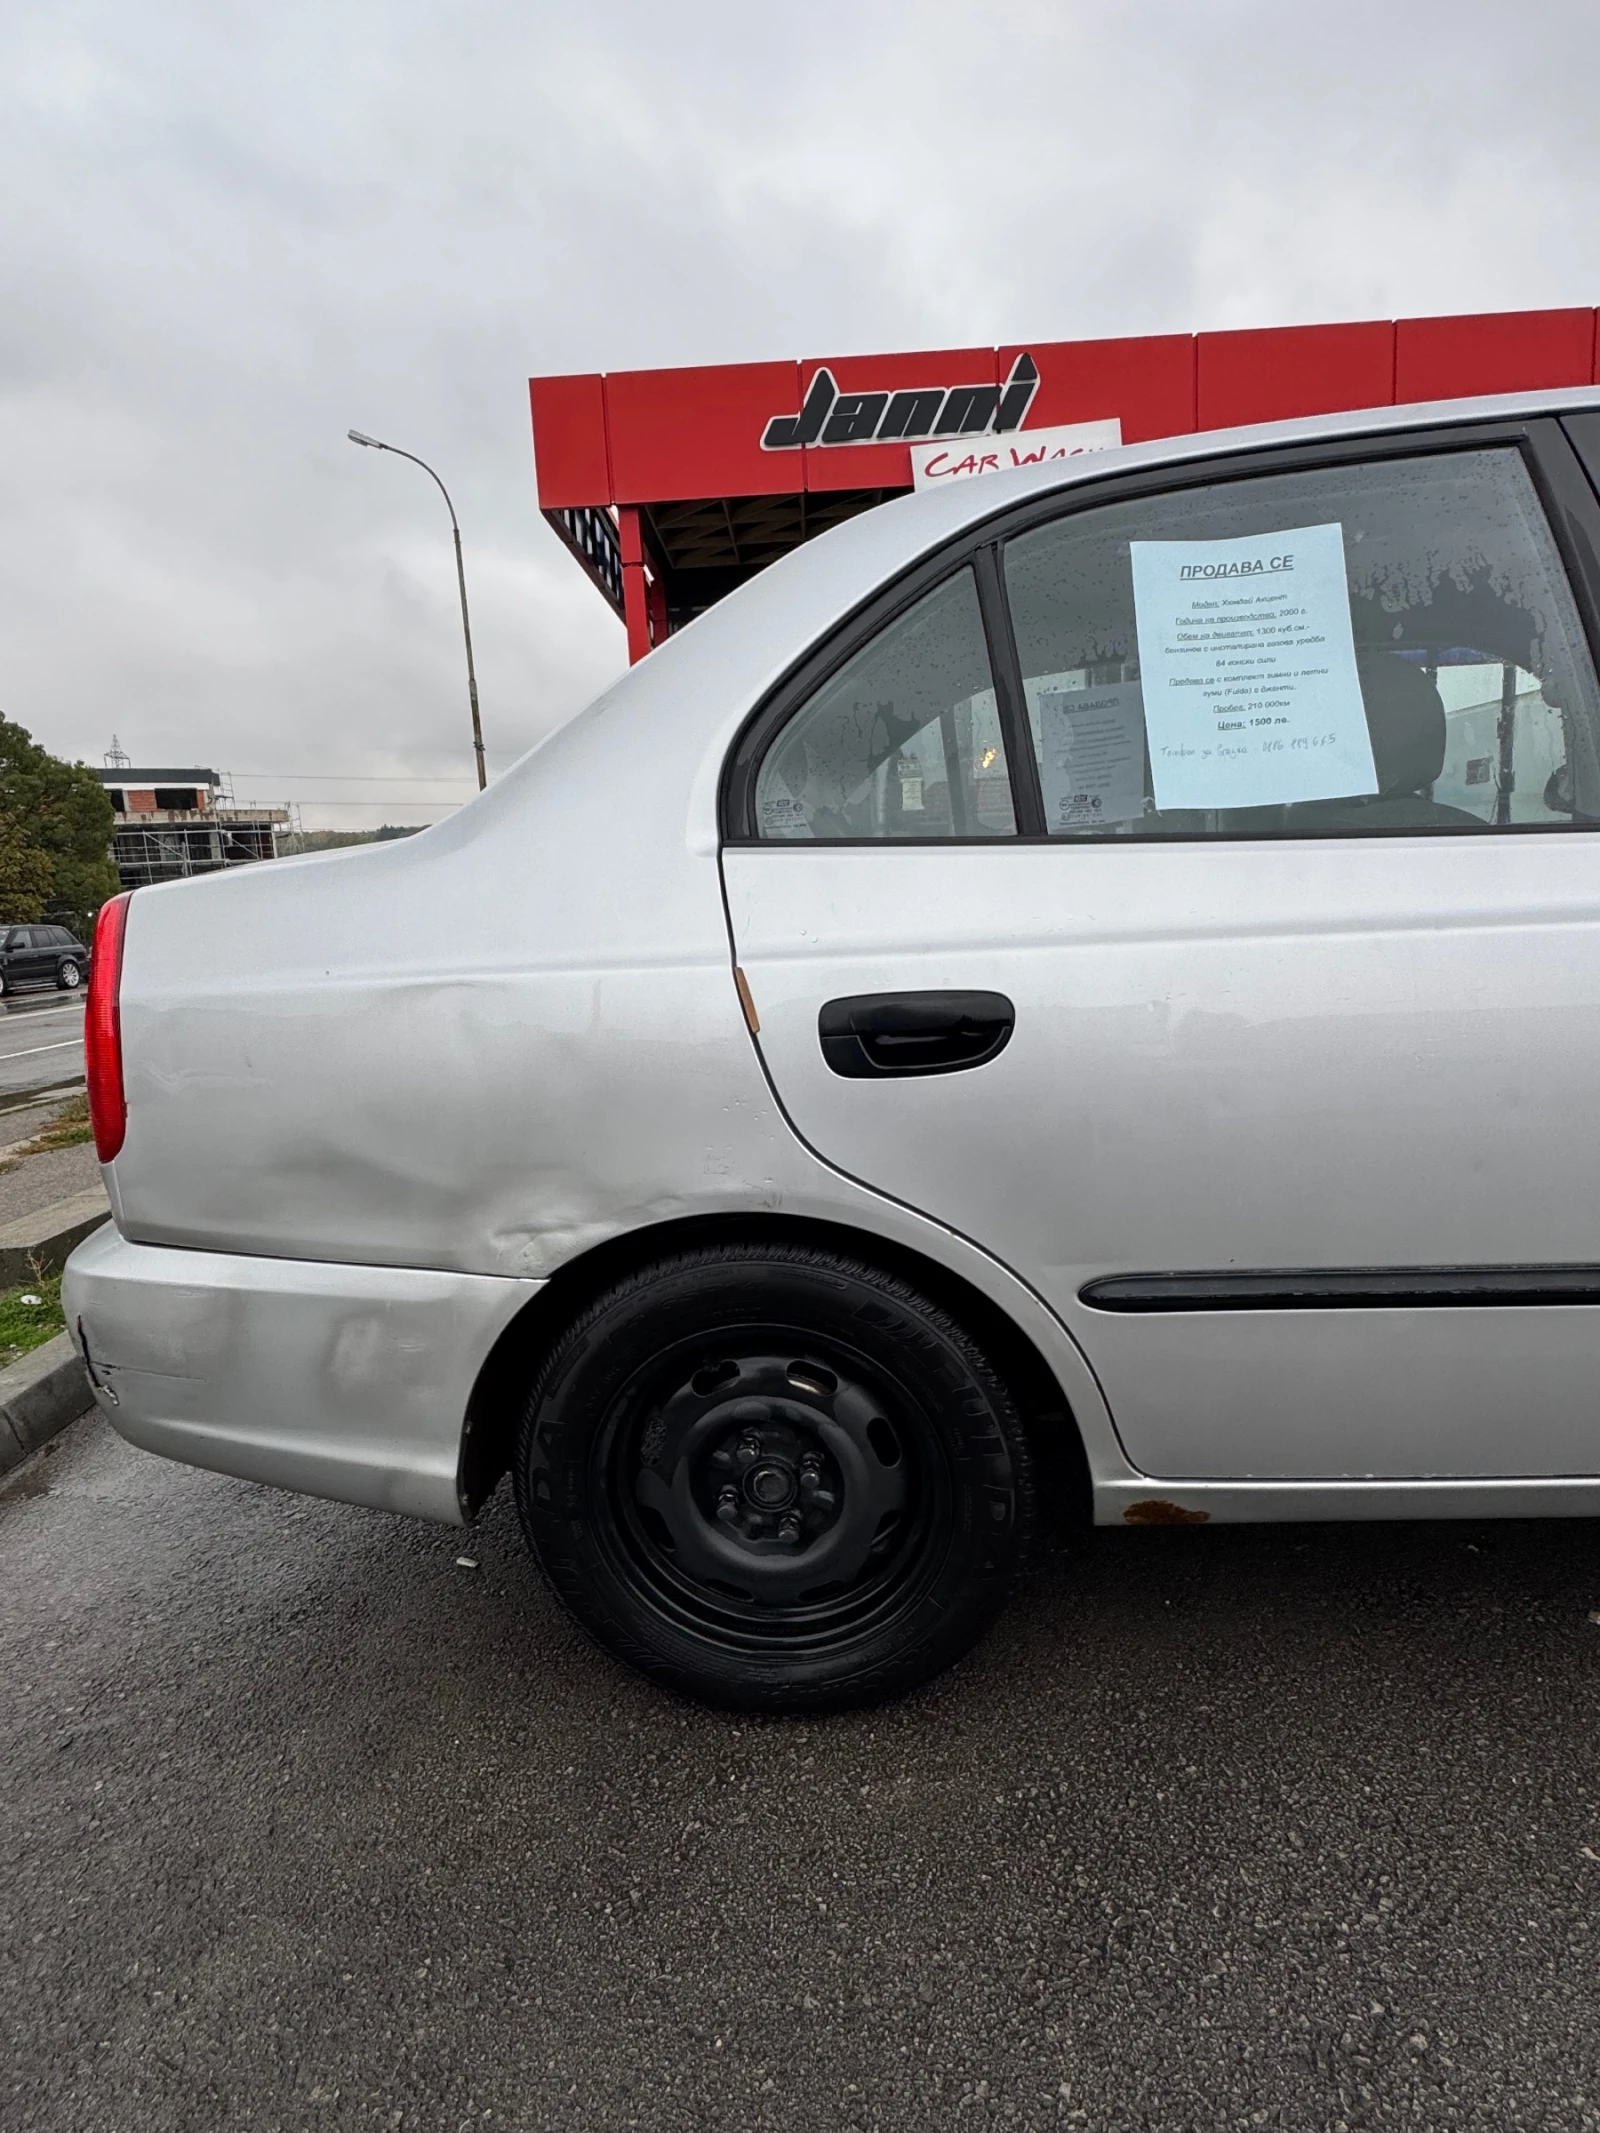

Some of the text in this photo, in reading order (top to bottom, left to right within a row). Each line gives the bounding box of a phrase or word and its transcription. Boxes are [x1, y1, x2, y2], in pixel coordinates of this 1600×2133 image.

[761, 351, 1038, 448] Janni
[924, 452, 999, 477] CAR
[1180, 554, 1294, 581] ПРОДАВА СЕ
[1192, 593, 1288, 609] Модел: Хюндай Акцент
[1175, 616, 1203, 626] Година
[1205, 616, 1215, 624] на
[1279, 608, 1299, 617] 2000
[1176, 632, 1199, 641] Обем
[1256, 626, 1276, 635] 1300
[1223, 673, 1265, 683] комплект
[1300, 667, 1329, 676] летни
[1224, 686, 1252, 697] (Fulda)
[1247, 701, 1263, 710] 210
[1217, 720, 1246, 731] Цена:
[1249, 717, 1272, 727] 1500
